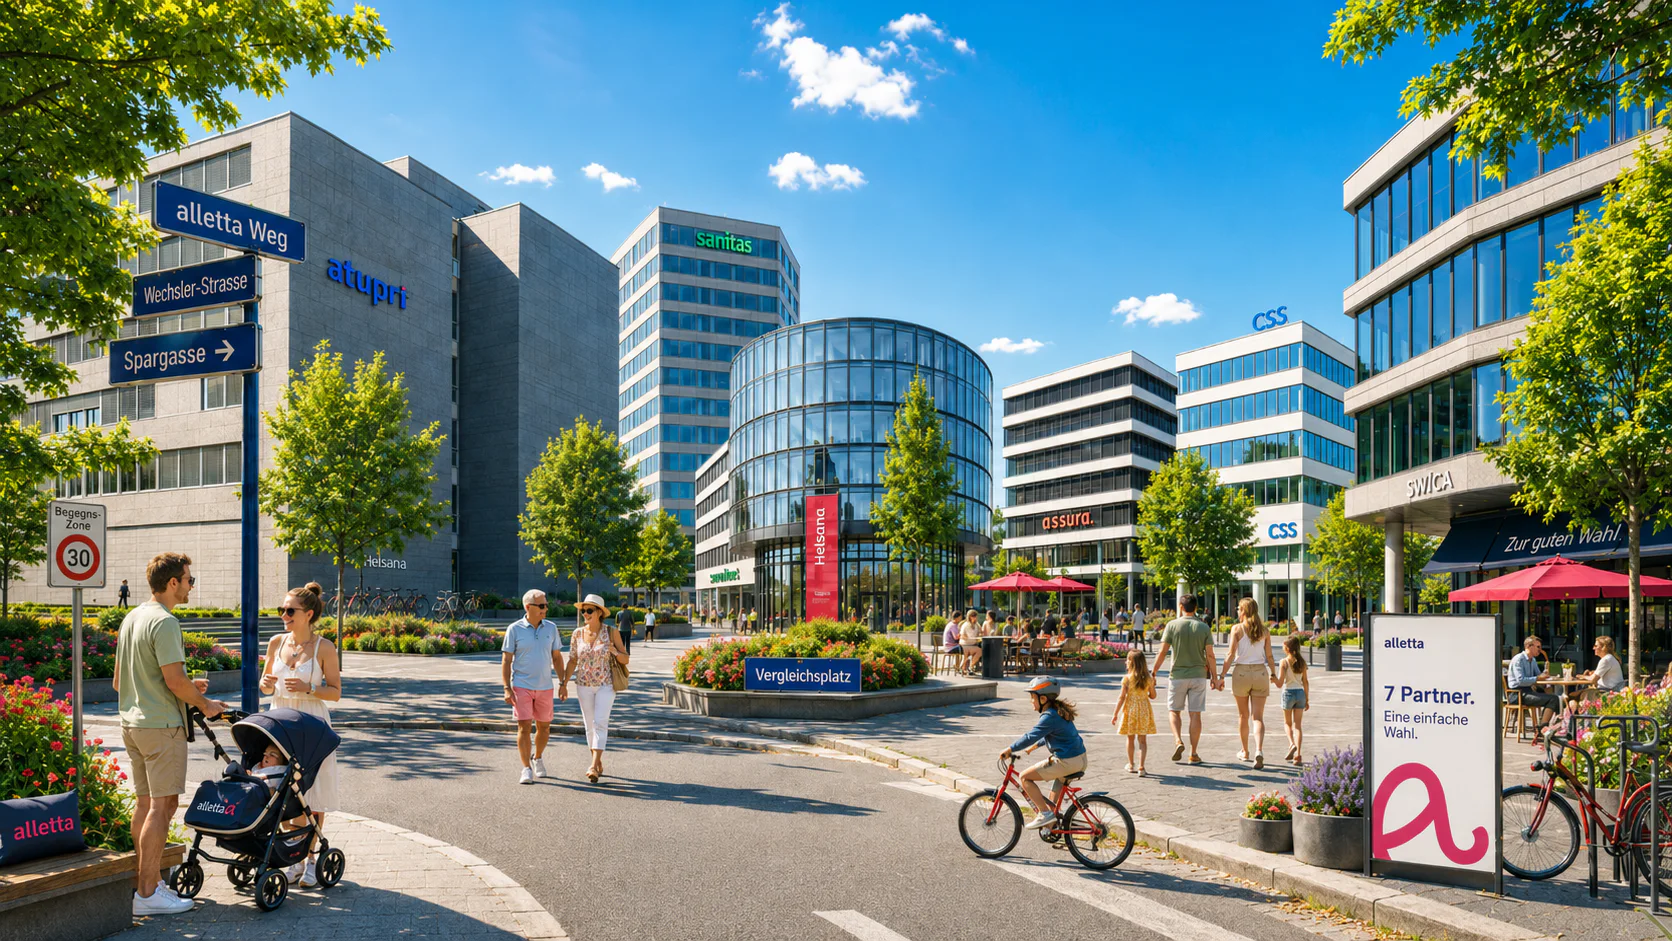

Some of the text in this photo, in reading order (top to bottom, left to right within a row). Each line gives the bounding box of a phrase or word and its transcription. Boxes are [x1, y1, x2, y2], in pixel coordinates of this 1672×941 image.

[177, 202, 288, 252] alletta Weg
[696, 230, 752, 253] sanitas
[144, 274, 248, 304] Wechsler-Strasse
[327, 258, 407, 310] atupri
[1252, 305, 1288, 331] CSS
[124, 347, 206, 374] Spargasse
[1407, 471, 1454, 498] SWICA
[55, 506, 101, 520] Begegns-
[1042, 511, 1094, 530] assura.
[65, 519, 91, 531] Zone
[1268, 521, 1298, 539] CSS
[814, 507, 825, 565] Helsana
[1504, 523, 1622, 555] Zur guten Wahl.
[67, 548, 90, 567] 30
[1384, 637, 1424, 649] alletta
[755, 667, 851, 686] Vergleichsplatz
[1384, 685, 1475, 705] 7 Partner.
[1384, 710, 1469, 726] Eine einfache
[1384, 726, 1418, 740] Wahl.
[196, 801, 225, 814] alletta
[13, 816, 75, 841] alletta
